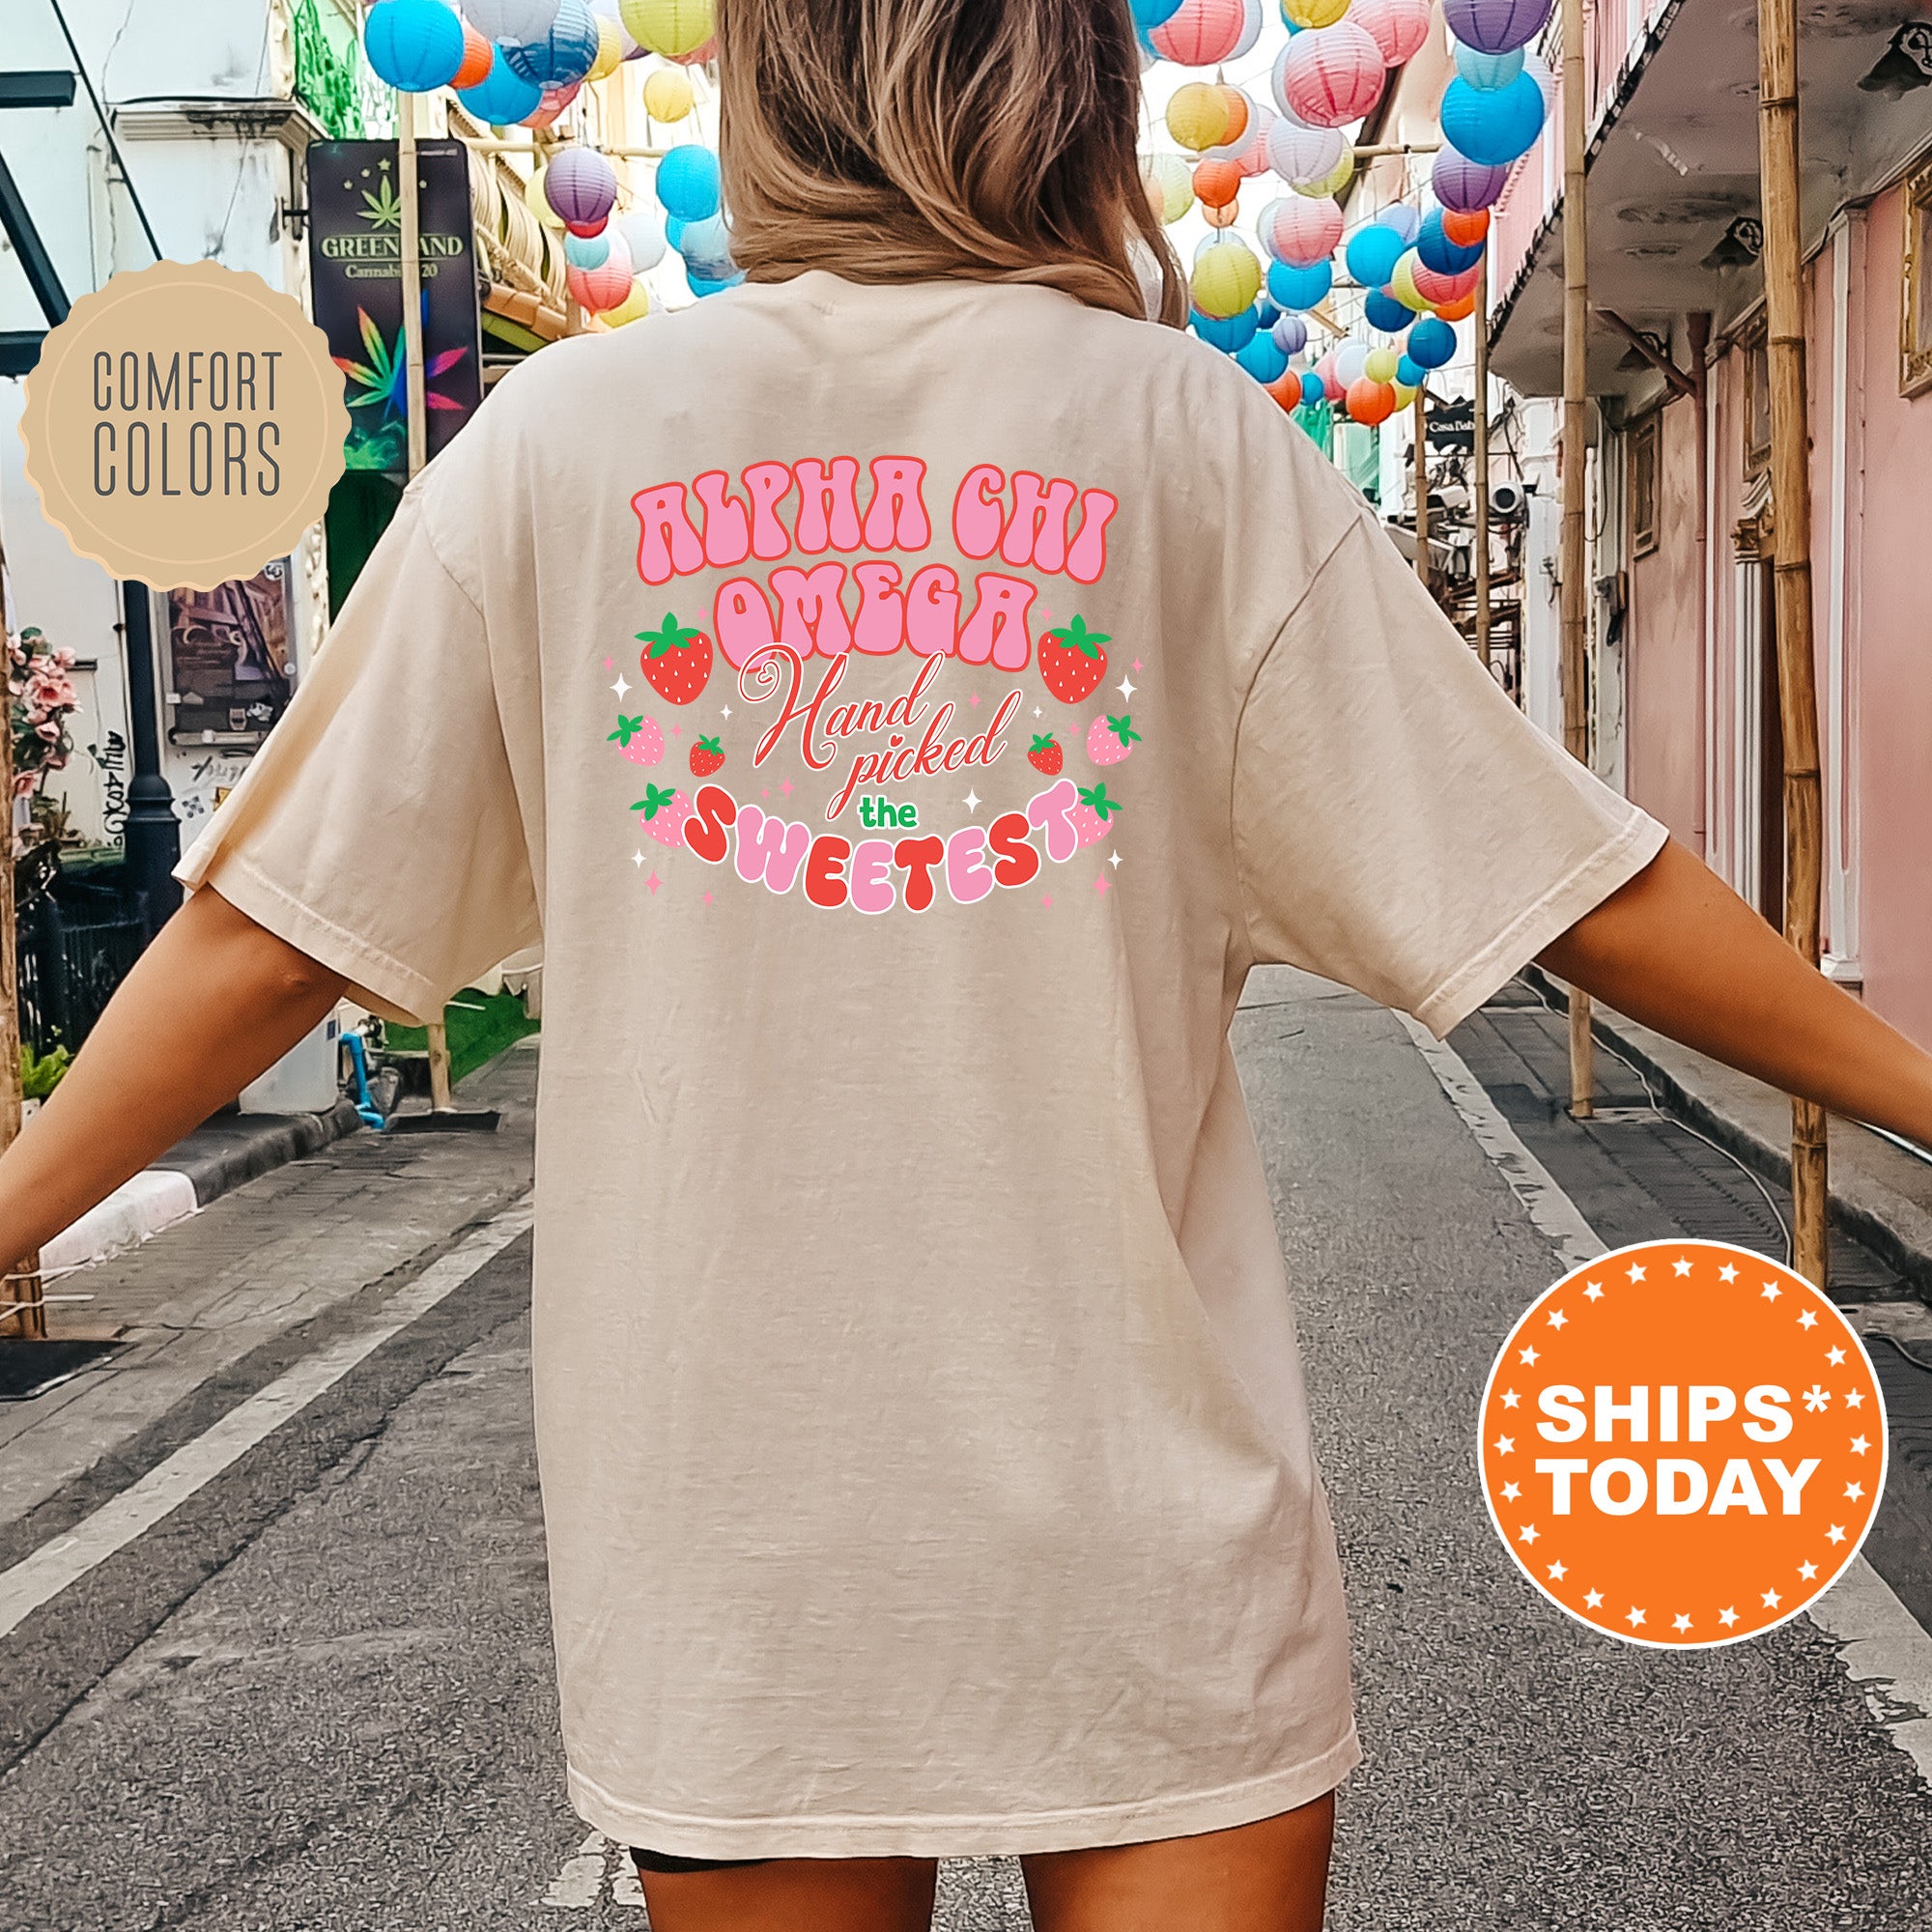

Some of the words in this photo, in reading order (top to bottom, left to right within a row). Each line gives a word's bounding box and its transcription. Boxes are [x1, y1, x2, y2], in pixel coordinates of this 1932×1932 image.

[321, 236, 464, 257] GREENAND
[631, 456, 932, 586] ALPHA
[952, 464, 1119, 584] CHI
[713, 561, 1038, 673] OMEGA
[738, 642, 946, 771] Hand
[825, 689, 1024, 821] picked
[682, 779, 1080, 915] SWEETEST
[859, 796, 918, 829] the
